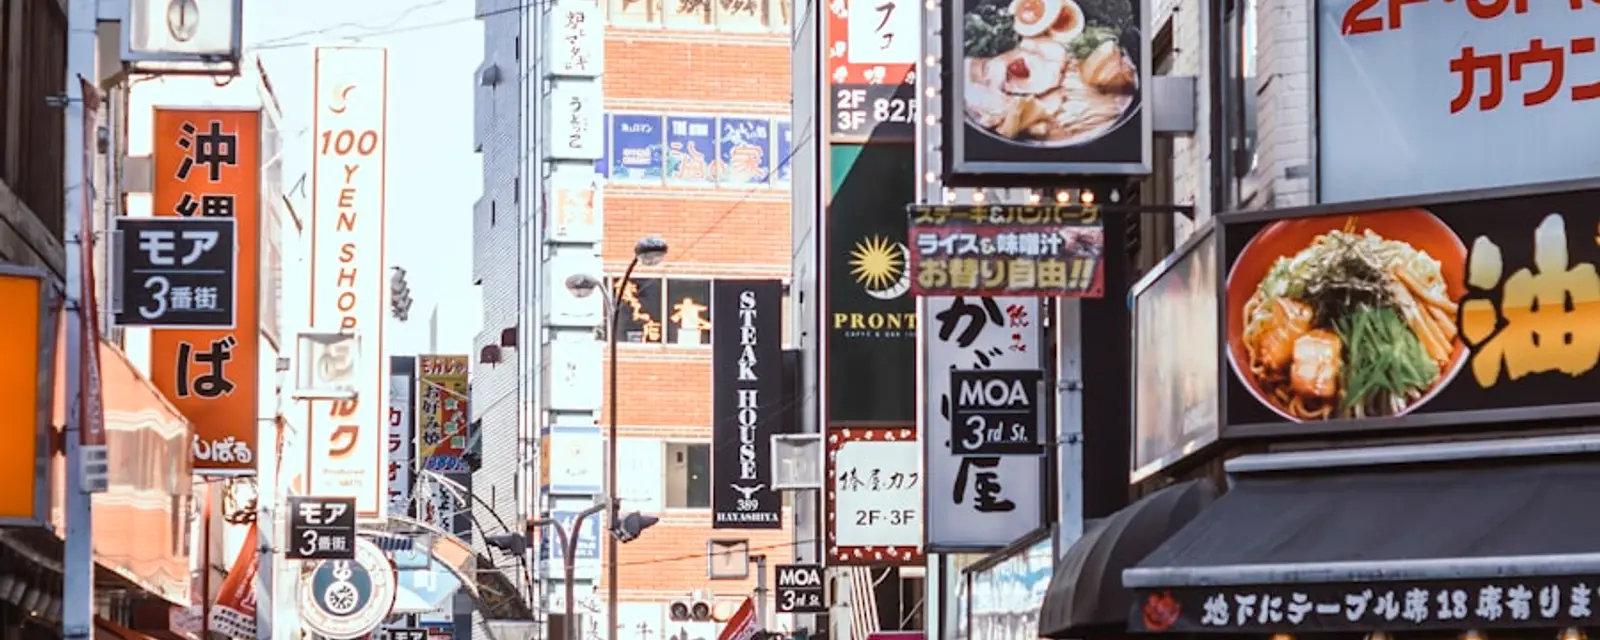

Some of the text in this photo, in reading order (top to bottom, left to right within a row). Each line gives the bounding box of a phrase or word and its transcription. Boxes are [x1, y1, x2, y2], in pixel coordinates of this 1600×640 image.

[837, 90, 866, 108] 2F
[837, 110, 866, 130] 3F
[321, 129, 378, 156] 100
[138, 230, 219, 265] モア
[336, 164, 360, 334] YEN SHOP
[138, 275, 217, 318] 3番街
[738, 291, 758, 480] STEAK HOUSE
[959, 381, 1029, 406] MOA
[962, 416, 1028, 449] 3rd St.
[299, 503, 347, 525] モア
[716, 512, 779, 523] HAYASHIYA
[737, 500, 758, 512] 389
[299, 530, 346, 556] 3番街
[779, 569, 821, 587] MOA
[782, 590, 821, 611] 3rd St.
